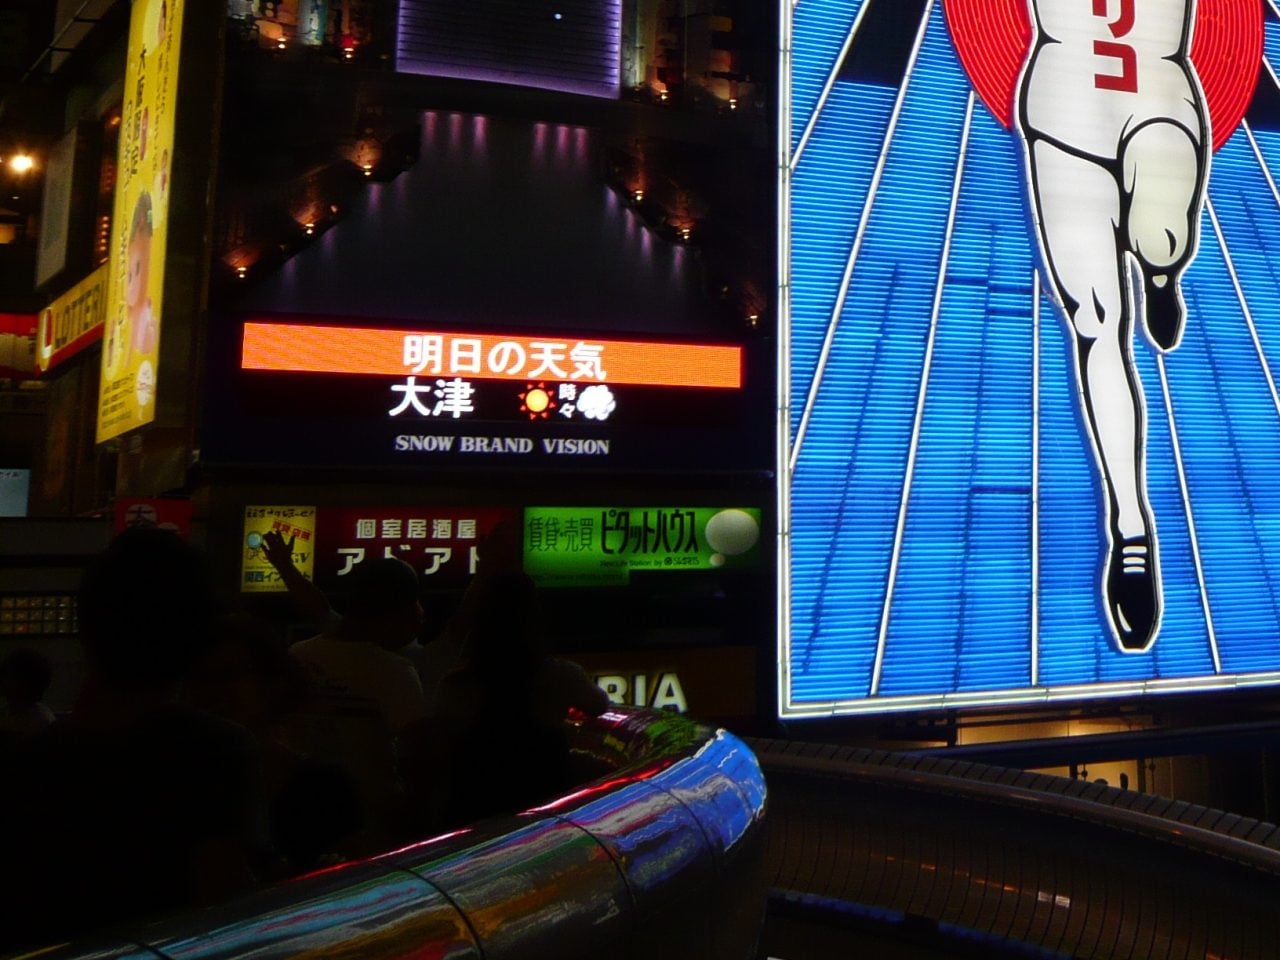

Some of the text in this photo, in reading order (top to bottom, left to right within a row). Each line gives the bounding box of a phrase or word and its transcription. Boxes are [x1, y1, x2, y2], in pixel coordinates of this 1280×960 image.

[401, 334, 608, 381] 明日の天気
[388, 377, 475, 419] 大津
[395, 433, 611, 456] SNOW BRAND VISION
[354, 518, 478, 540] 個室居酒屋
[528, 515, 595, 554] 賃貸・売買
[600, 509, 701, 556] ピタットハウス
